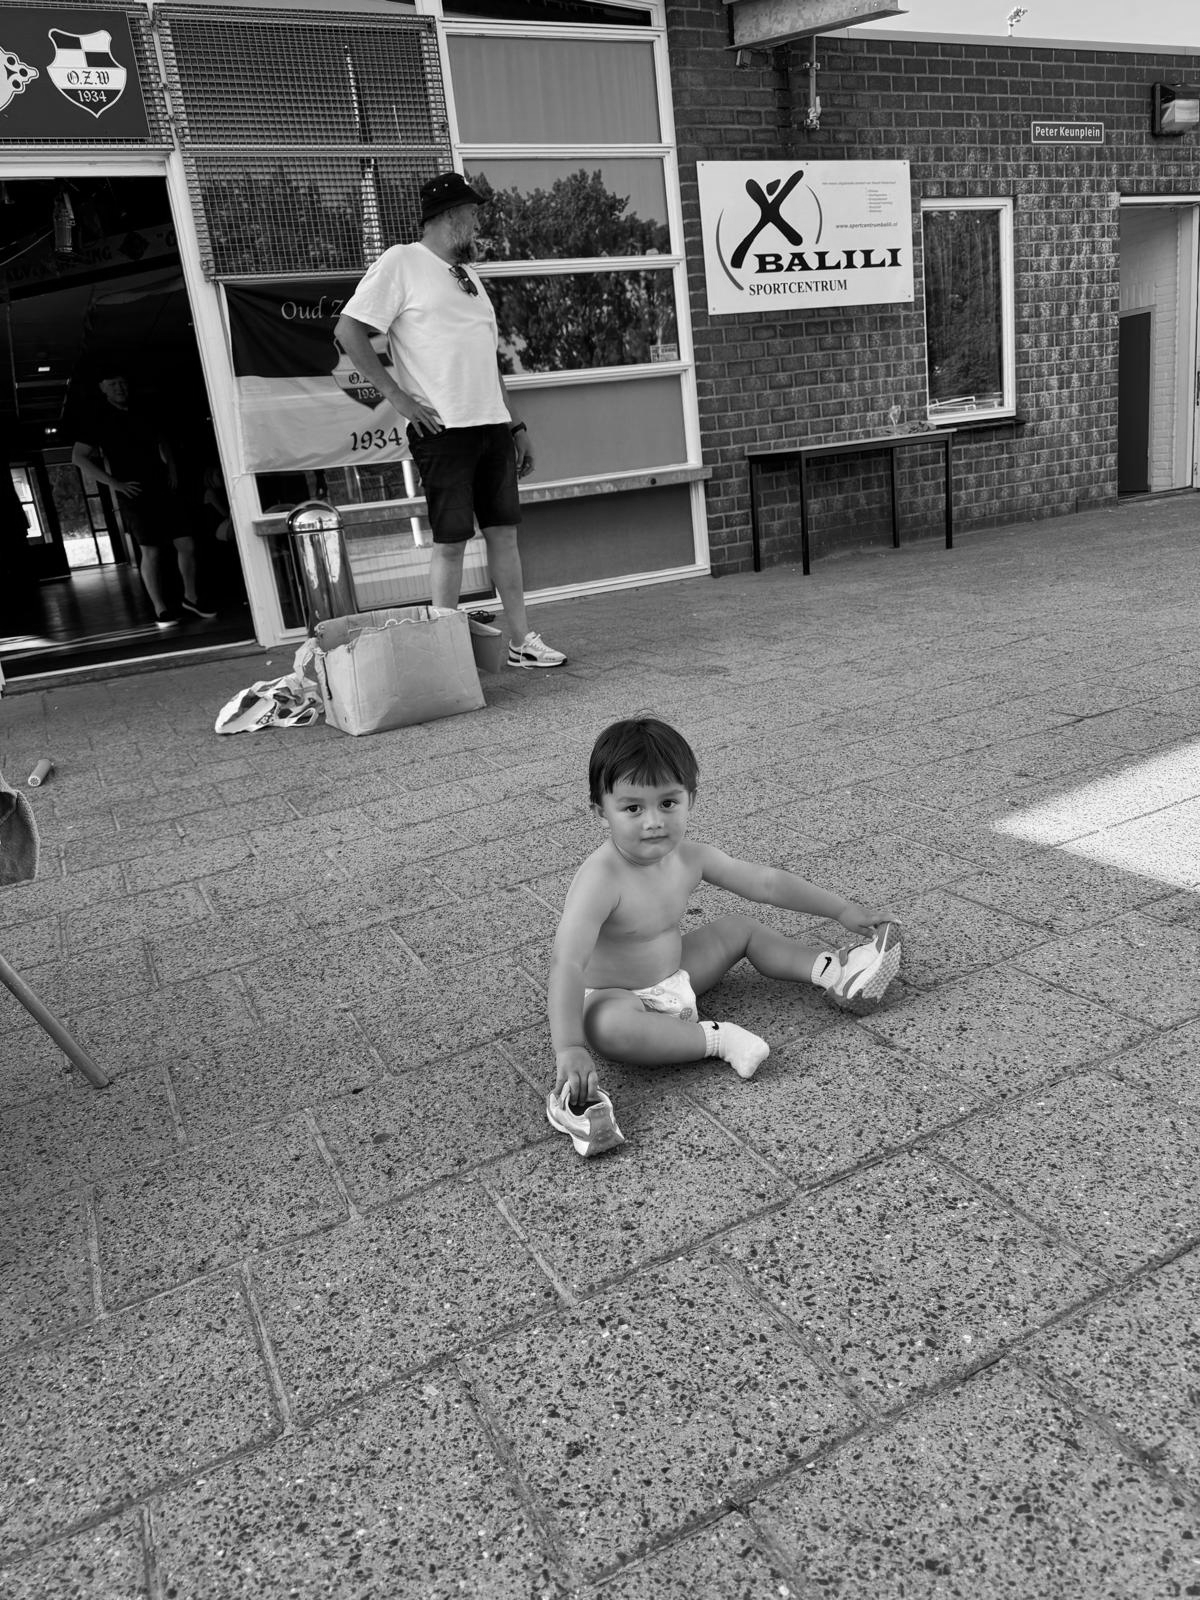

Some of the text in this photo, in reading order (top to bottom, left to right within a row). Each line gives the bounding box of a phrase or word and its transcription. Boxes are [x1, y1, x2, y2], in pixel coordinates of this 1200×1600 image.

[78, 90, 107, 102] 1934
[1035, 126, 1100, 139] Peter Keunplein
[753, 248, 902, 273] BALILI
[748, 279, 848, 296] SPORTCENTRUM
[281, 295, 327, 320] Oud
[350, 427, 402, 451] 1934
